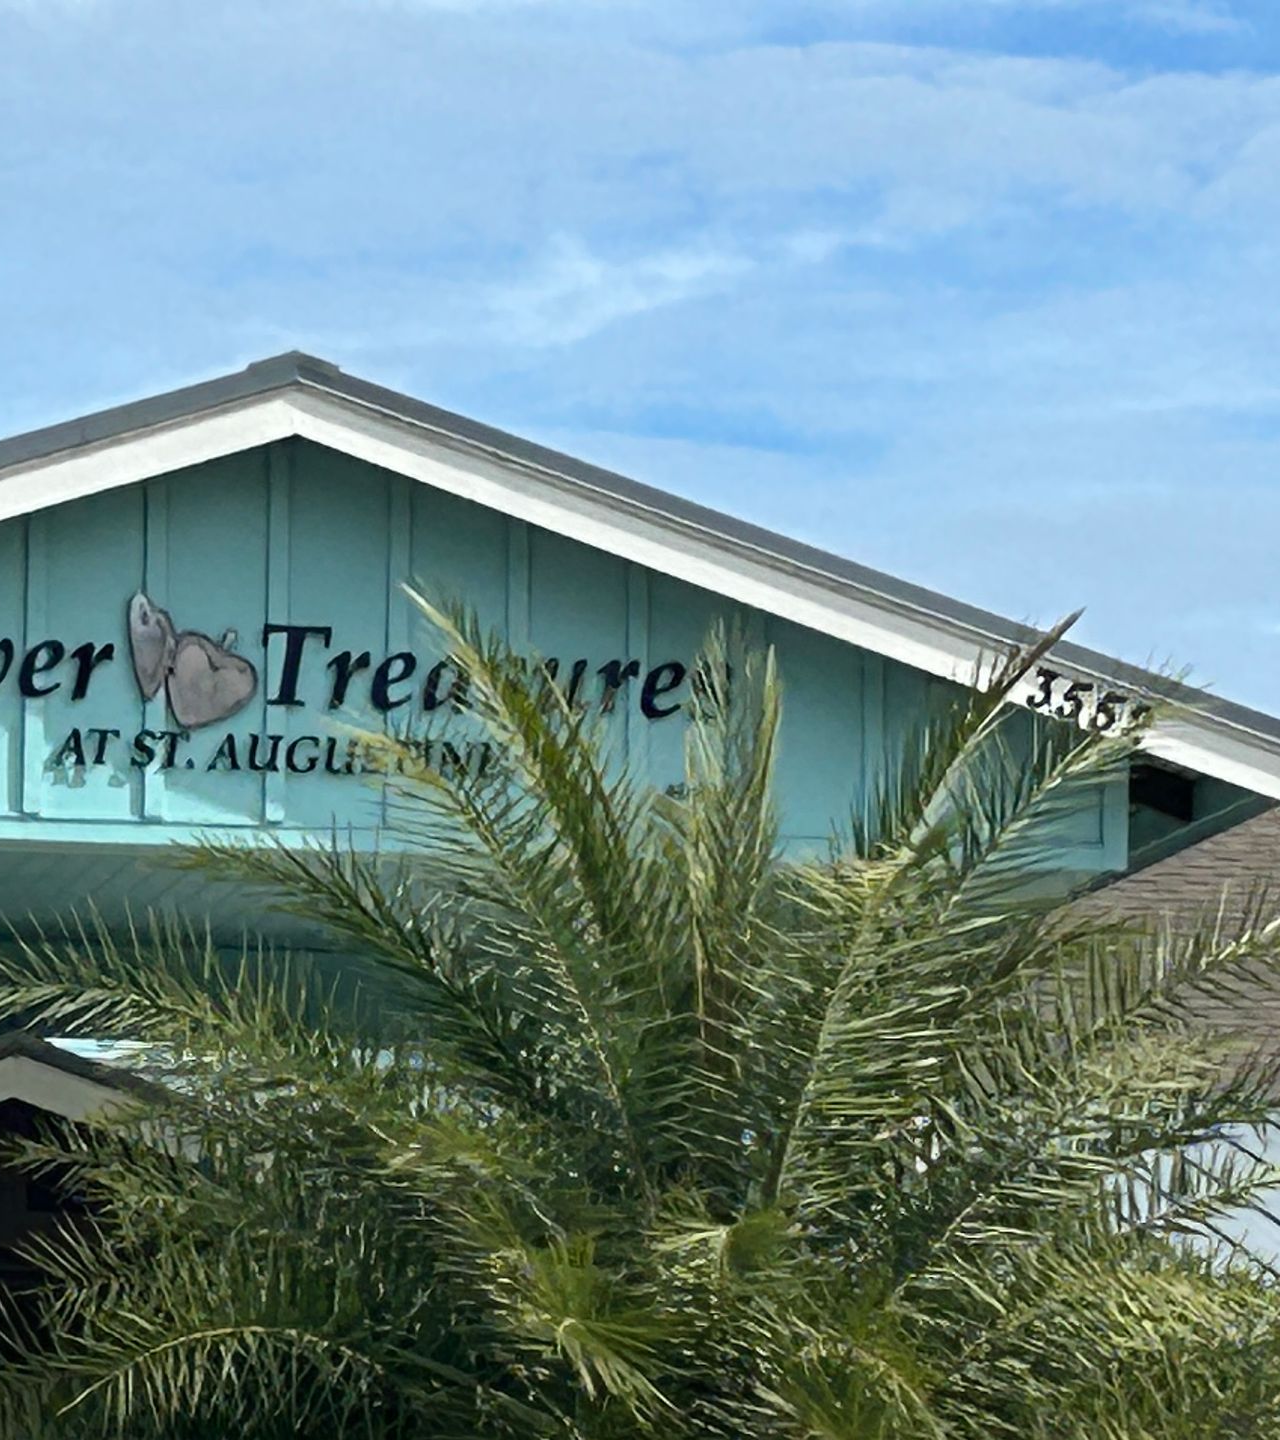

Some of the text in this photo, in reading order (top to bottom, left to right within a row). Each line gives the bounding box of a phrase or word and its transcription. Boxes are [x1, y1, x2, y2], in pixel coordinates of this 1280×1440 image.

[262, 623, 732, 722] Treaure
[50, 727, 121, 767] AT
[130, 728, 196, 771] ST.
